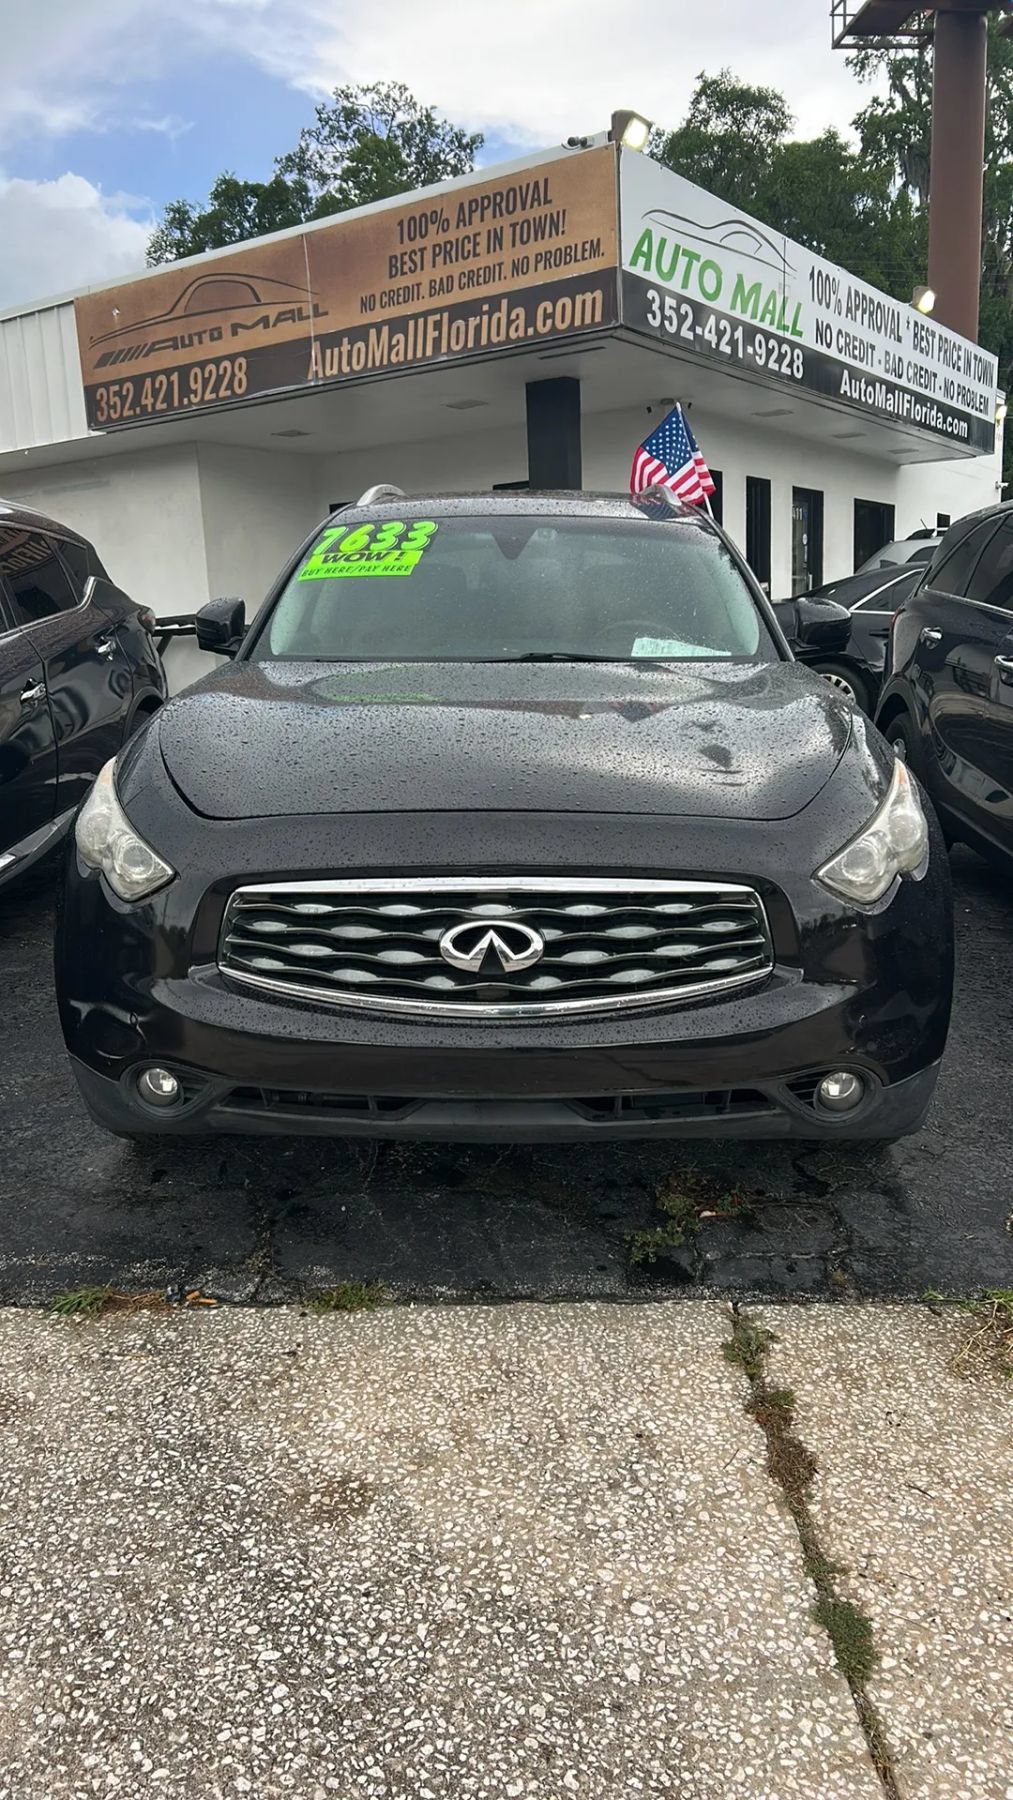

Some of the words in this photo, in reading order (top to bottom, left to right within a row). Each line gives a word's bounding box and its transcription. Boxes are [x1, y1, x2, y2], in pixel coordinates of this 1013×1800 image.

[388, 247, 426, 279] BEST
[432, 234, 480, 269] PRICE
[487, 229, 504, 255] IN
[509, 209, 566, 248] TOWN!
[397, 208, 449, 244] 100%
[456, 177, 552, 229] APPROVAL
[360, 294, 376, 314] NO
[380, 284, 424, 308] CREDIT.
[429, 275, 454, 297] BAD
[458, 262, 507, 292] CREDIT.
[512, 256, 529, 278] NO
[534, 237, 605, 273] PROBLEM.
[629, 228, 723, 302] AUTO
[730, 273, 803, 338] MALL
[144, 326, 222, 357] AUTO
[231, 303, 329, 337] MALL
[307, 288, 604, 380] AutoMallFlorida.com
[646, 289, 804, 379] 352-421-9228
[809, 265, 842, 317] 100%
[845, 286, 902, 343] APPROVAL
[913, 320, 936, 359] BEST
[937, 336, 961, 373] PRICE
[963, 350, 972, 377] IN
[973, 354, 994, 389] TOWN
[96, 357, 248, 422] 352.421.9228
[815, 318, 833, 349] NO
[836, 328, 876, 368] CREDIT
[884, 350, 904, 380] BAD
[906, 361, 938, 394] CREDIT
[944, 378, 955, 400] NO
[956, 386, 989, 416] PROBLEM
[839, 369, 968, 438] AutoMallFlorida.com
[301, 568, 321, 577] BUY
[324, 565, 379, 574] HERE/PAY
[313, 521, 438, 555] 7633
